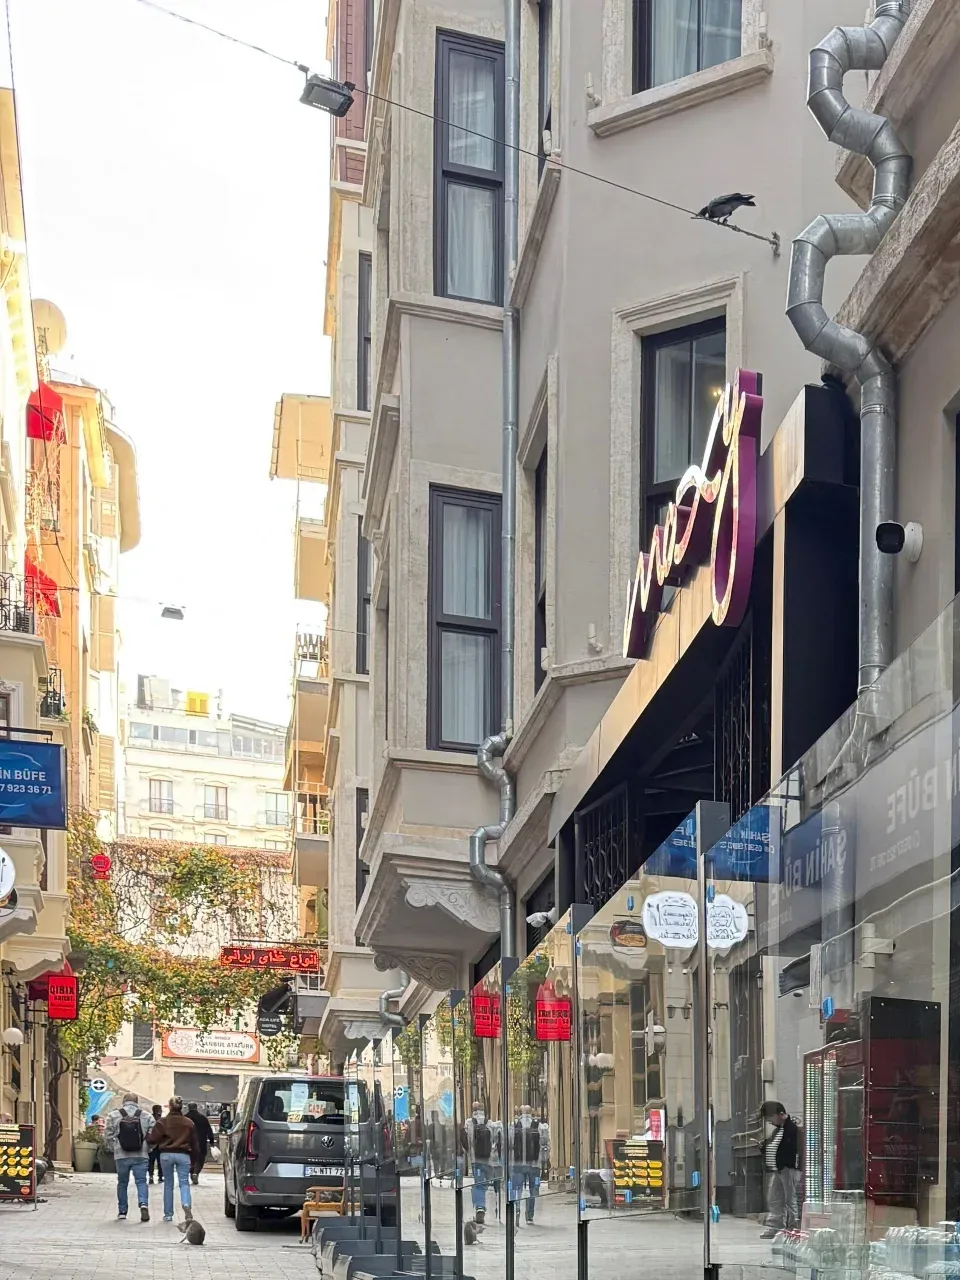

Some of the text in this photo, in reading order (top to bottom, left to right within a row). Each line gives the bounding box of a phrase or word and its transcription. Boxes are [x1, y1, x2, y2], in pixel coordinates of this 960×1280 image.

[14, 768, 46, 781] BÜFE
[7, 784, 25, 792] 923
[27, 785, 40, 794] 36
[41, 786, 52, 795] 71
